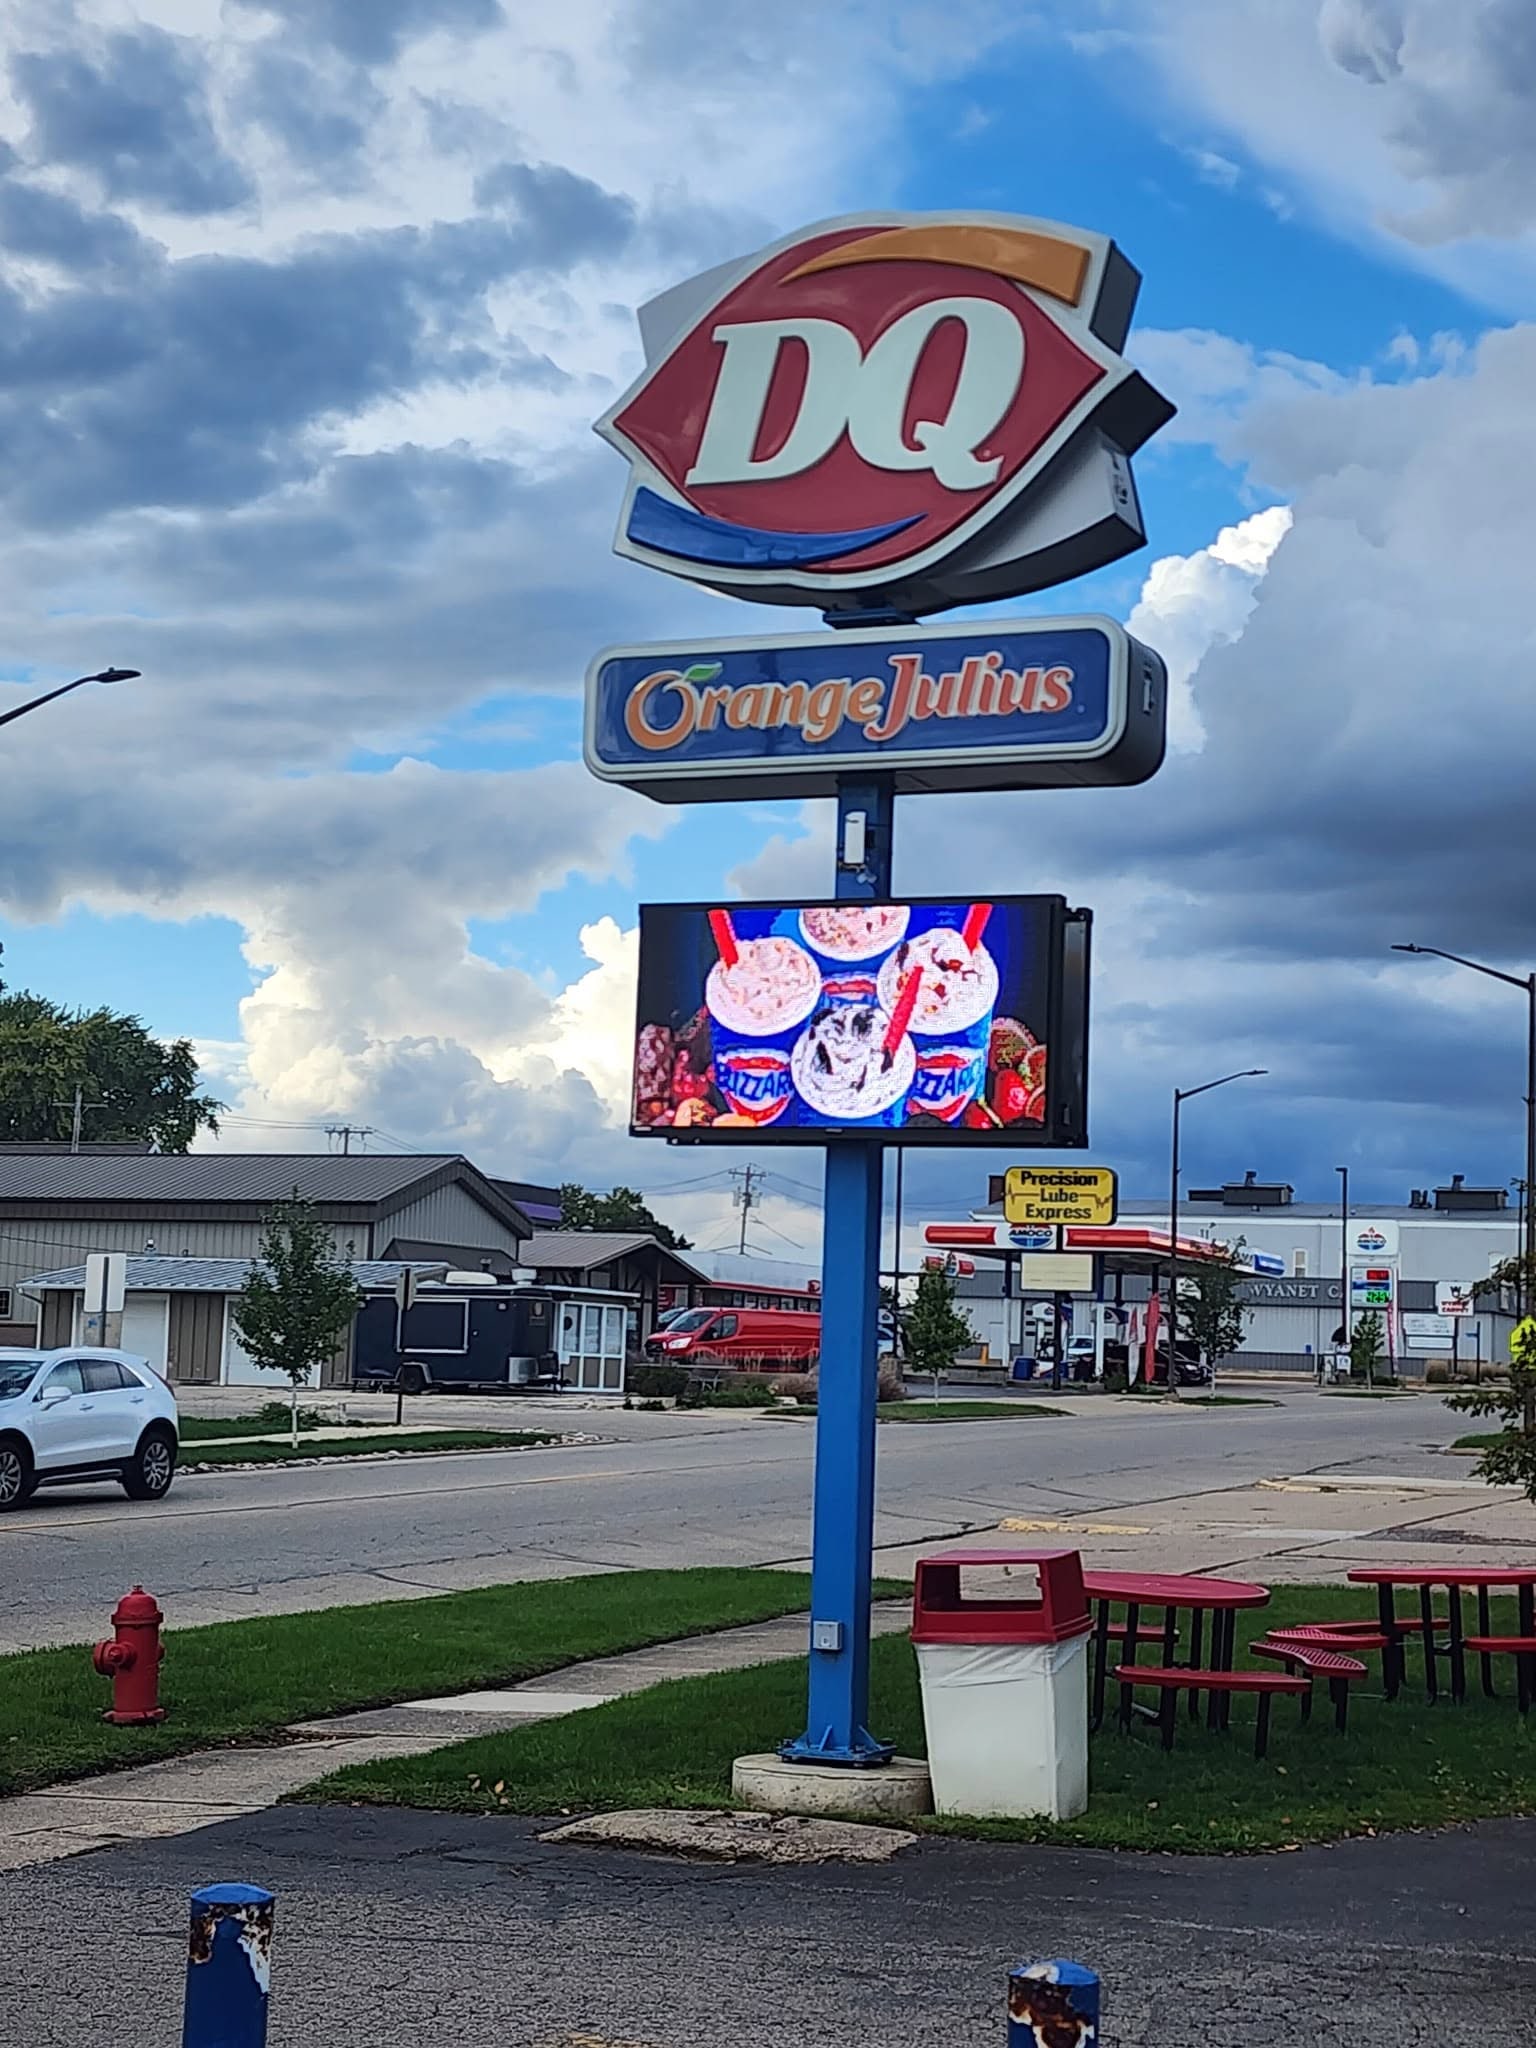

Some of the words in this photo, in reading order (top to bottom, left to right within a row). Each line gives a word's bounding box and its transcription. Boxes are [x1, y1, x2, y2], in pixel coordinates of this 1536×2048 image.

[684, 296, 1026, 491] DQ
[624, 664, 886, 751] Orange
[863, 650, 1075, 742] Julius
[1021, 1170, 1098, 1186] Precision
[1040, 1188, 1078, 1203] Lube
[1025, 1203, 1091, 1219] Express
[1008, 1229, 1053, 1237] AMOCO
[1250, 1283, 1319, 1299] WYANET
[1328, 1285, 1342, 1298] C
